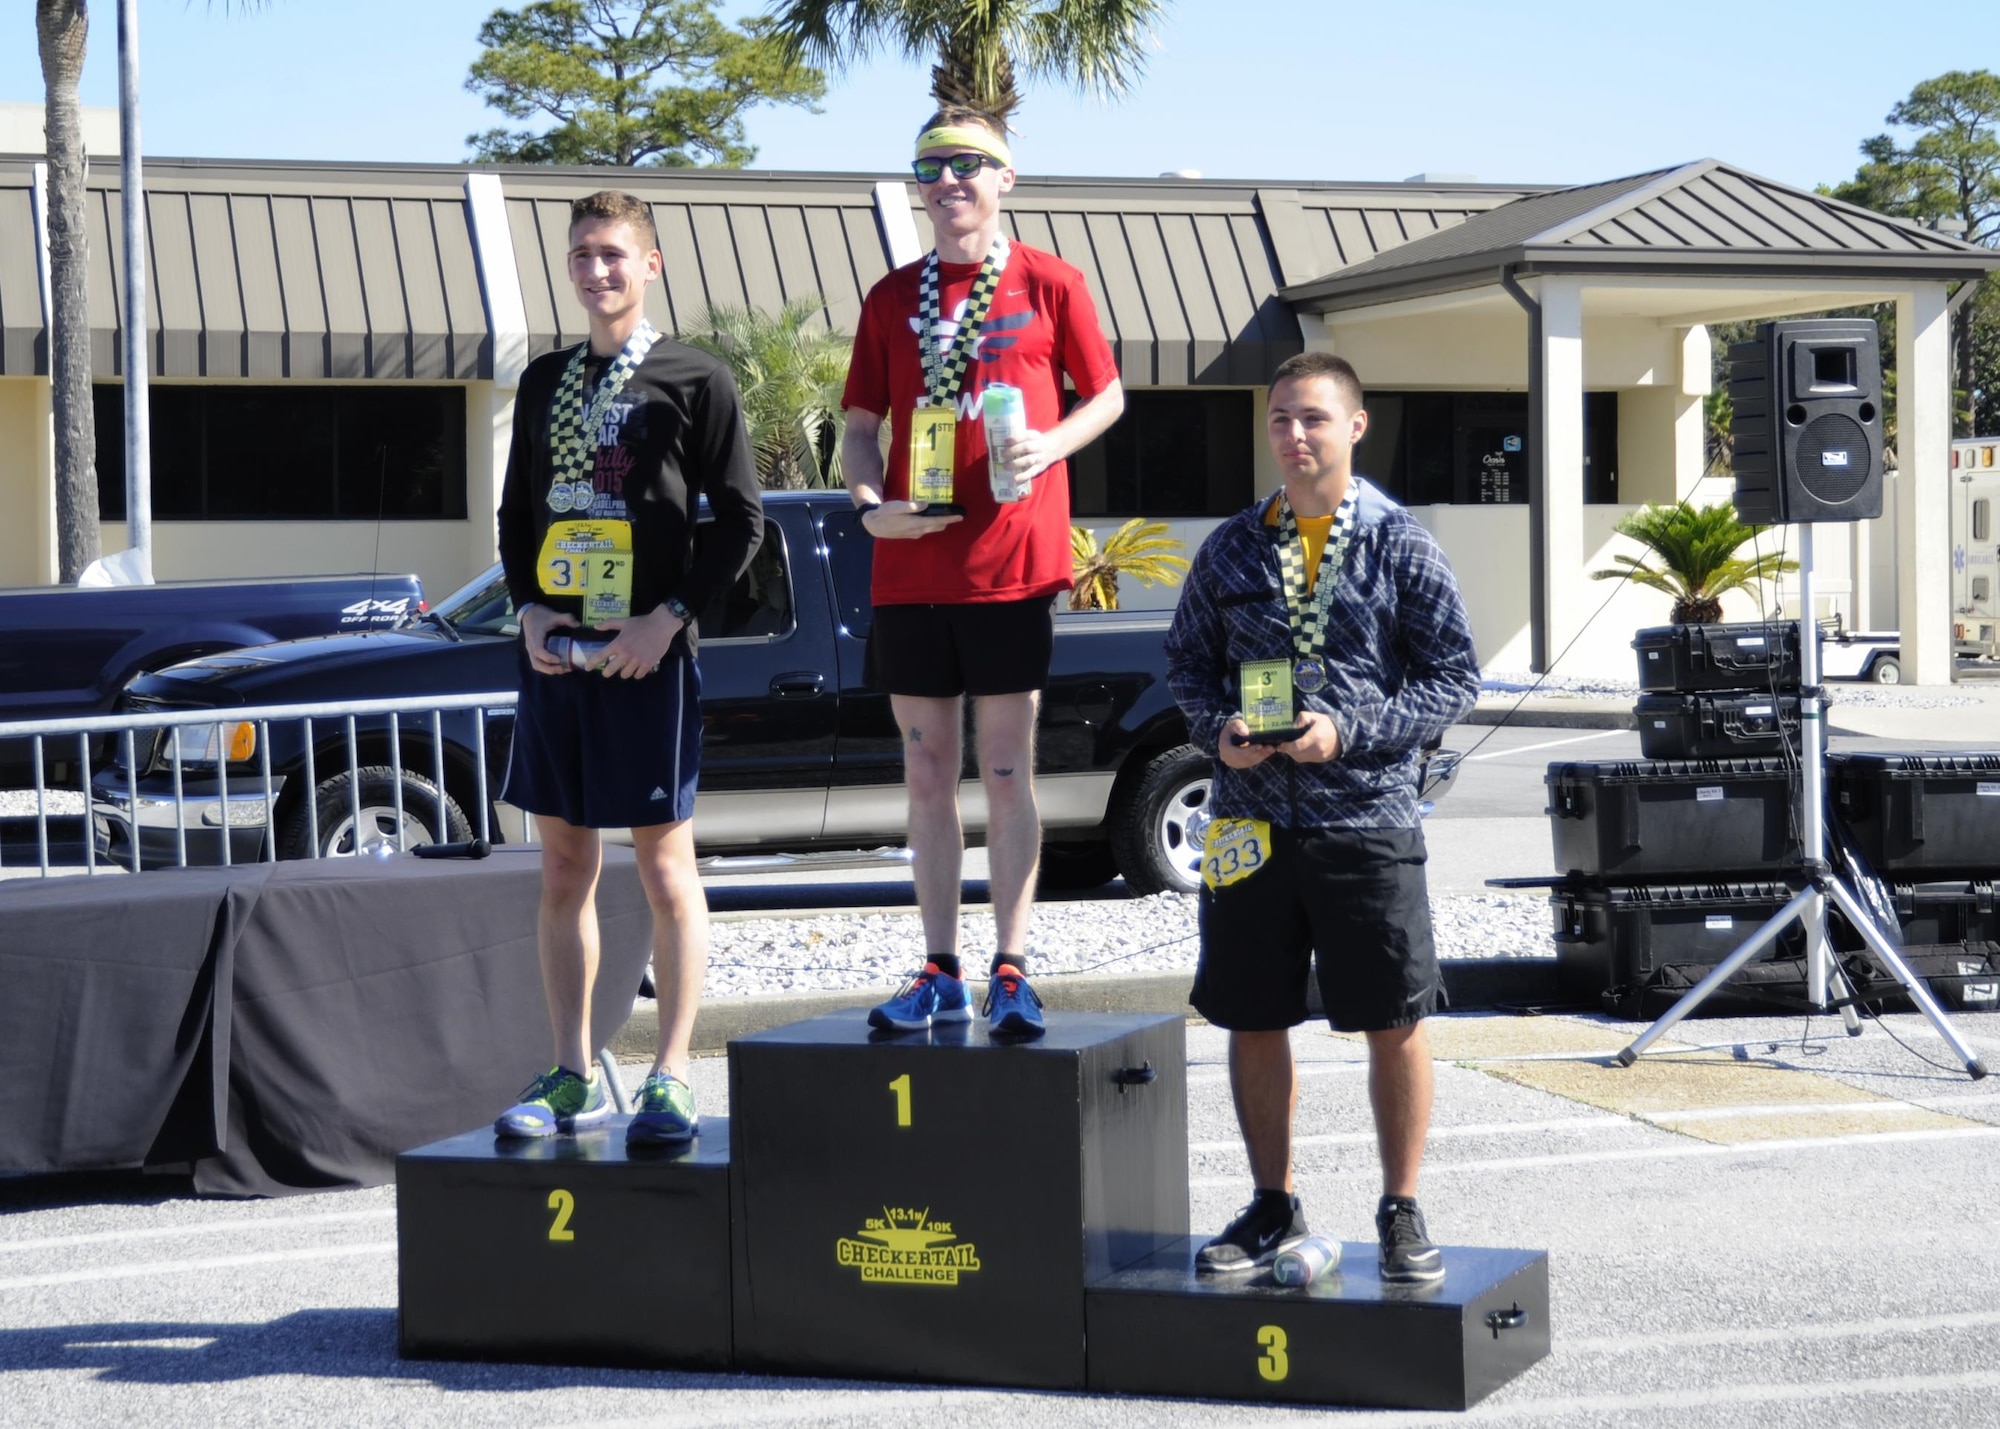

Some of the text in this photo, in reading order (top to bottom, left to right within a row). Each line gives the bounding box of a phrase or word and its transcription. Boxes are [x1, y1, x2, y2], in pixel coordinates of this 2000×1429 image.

[595, 446, 637, 477] hilly
[594, 471, 622, 492] 015
[341, 597, 410, 616] 4x4
[1207, 838, 1262, 882] 333
[889, 1074, 912, 1126] 1
[548, 1189, 575, 1241] 2
[865, 1218, 952, 1232] 5K 10K
[838, 1239, 979, 1269] CHECKERTAIL
[863, 1266, 956, 1282] CHALLENGE
[1256, 1325, 1288, 1382] 3
